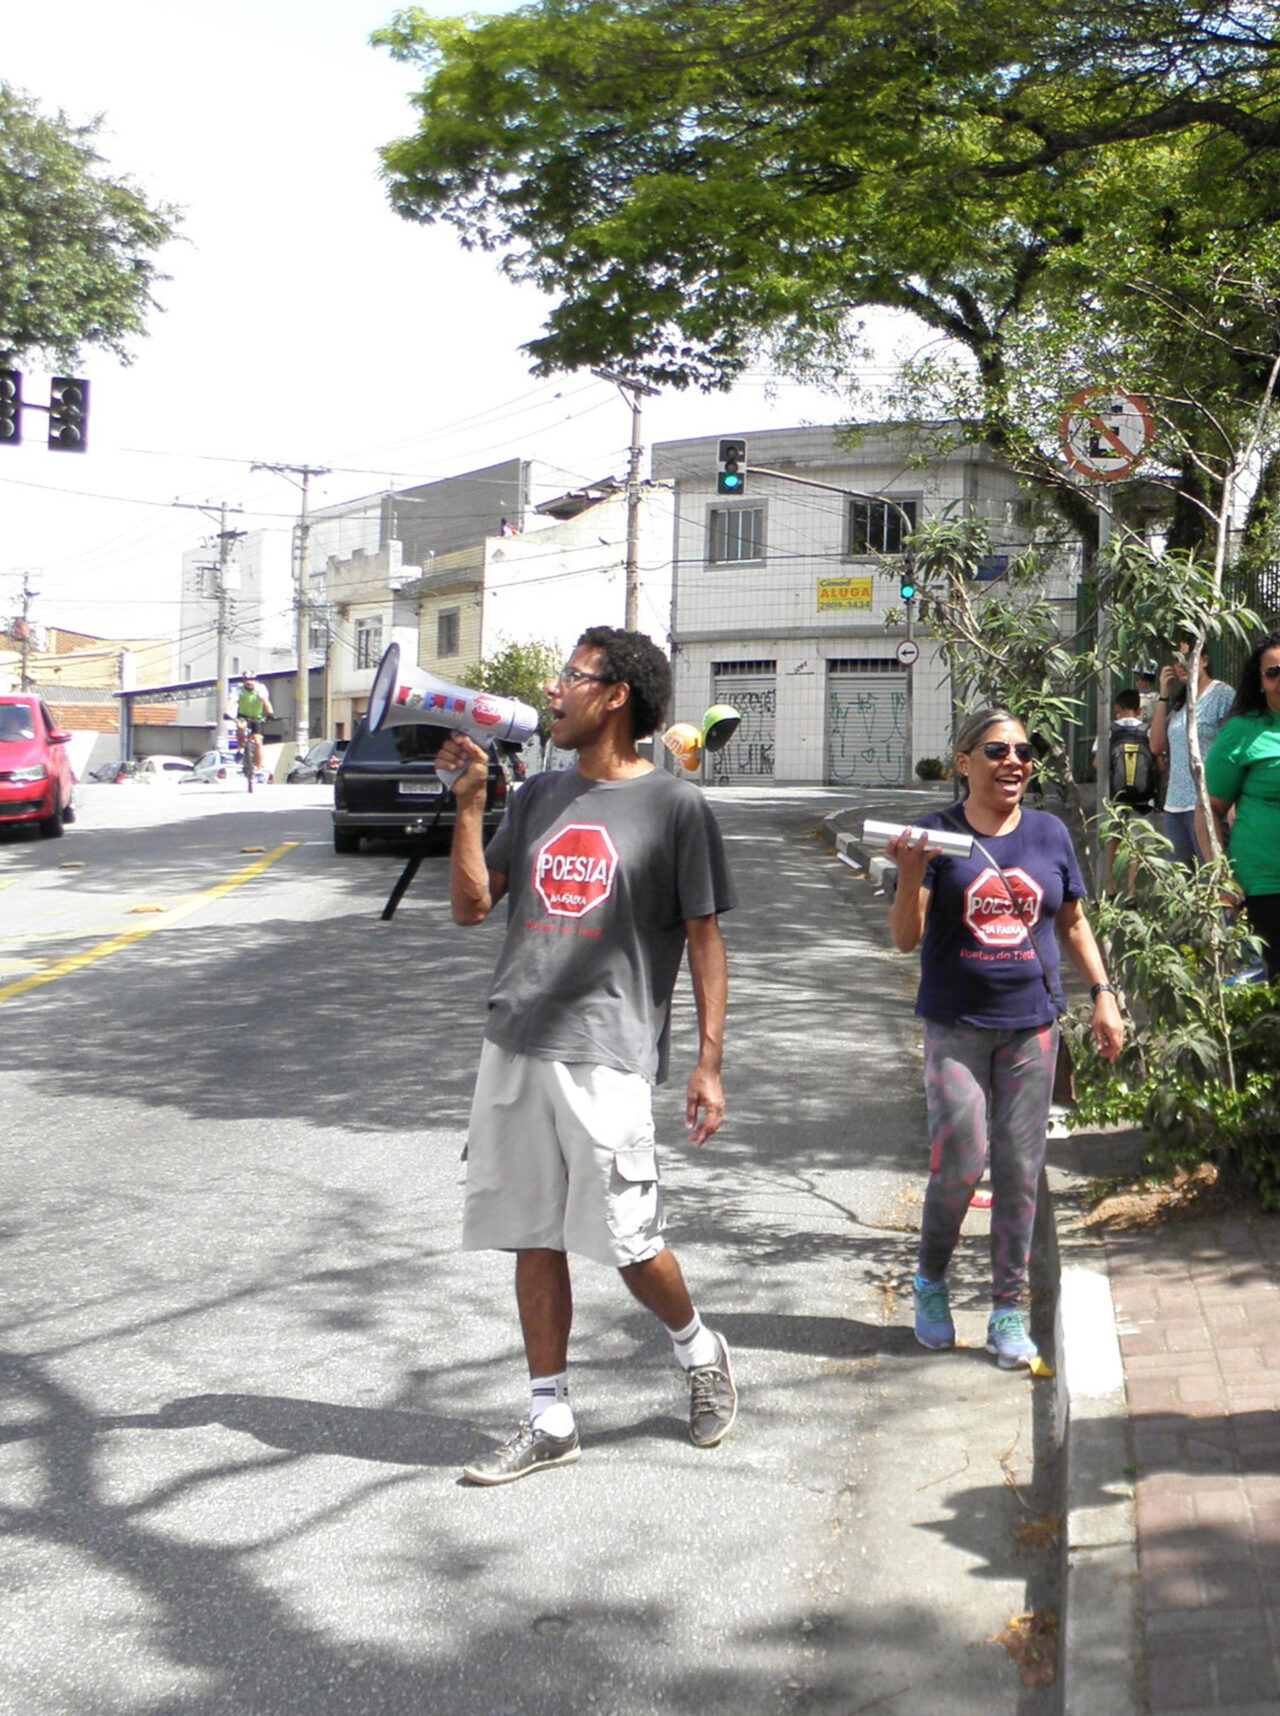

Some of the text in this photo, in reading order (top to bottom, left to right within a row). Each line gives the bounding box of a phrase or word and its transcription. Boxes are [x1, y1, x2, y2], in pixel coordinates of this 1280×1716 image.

[820, 588, 870, 598] ALUGA
[540, 854, 607, 886] POESIA
[961, 948, 995, 961] Poetas
[997, 952, 1010, 960] do
